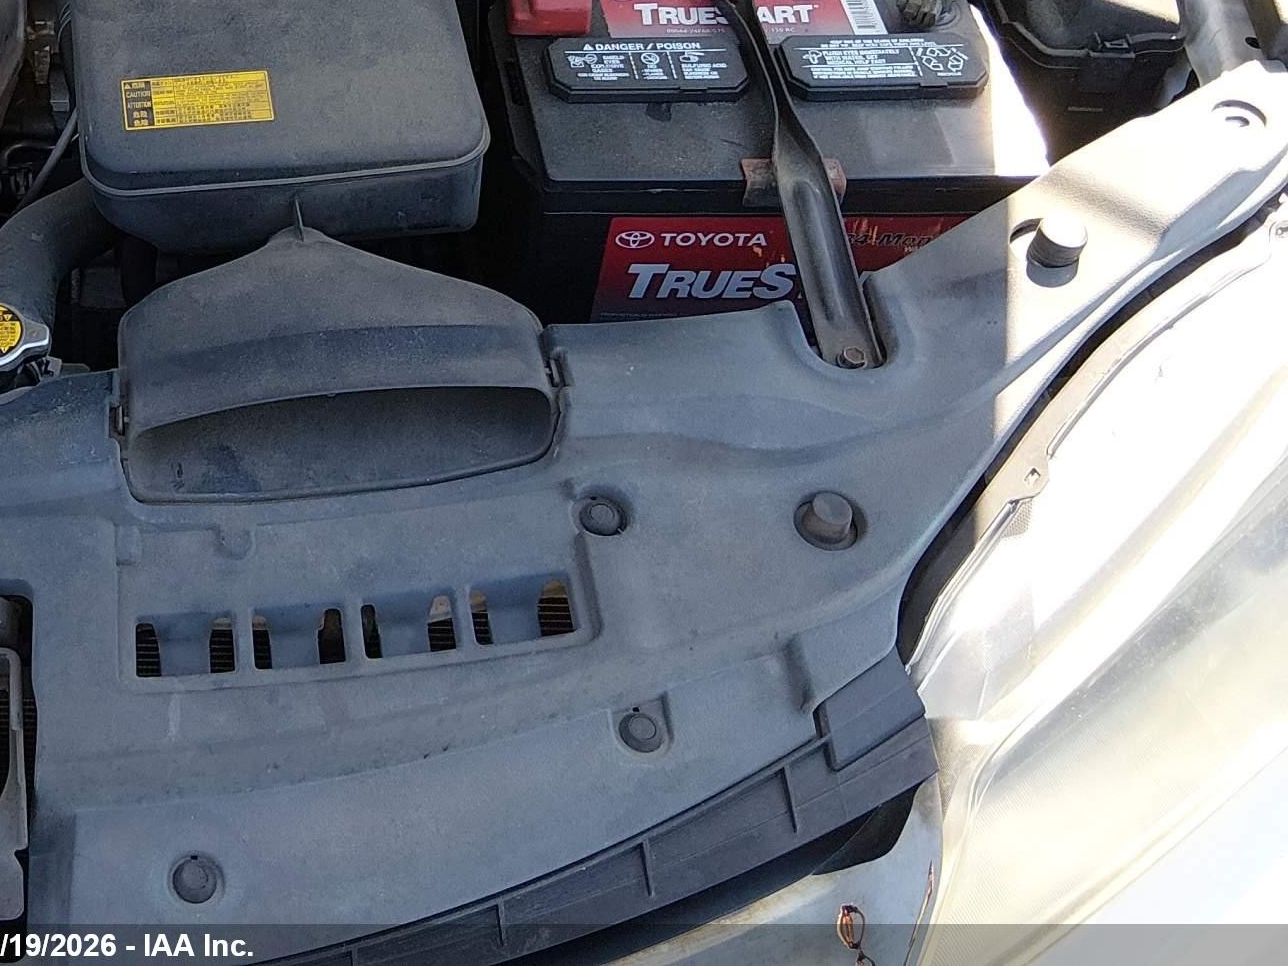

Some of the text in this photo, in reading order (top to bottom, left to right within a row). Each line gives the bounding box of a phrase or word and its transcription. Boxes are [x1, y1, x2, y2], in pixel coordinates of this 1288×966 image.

[596, 42, 645, 51] DANGER
[656, 42, 701, 50] POISON
[661, 233, 767, 247] TOYOTA
